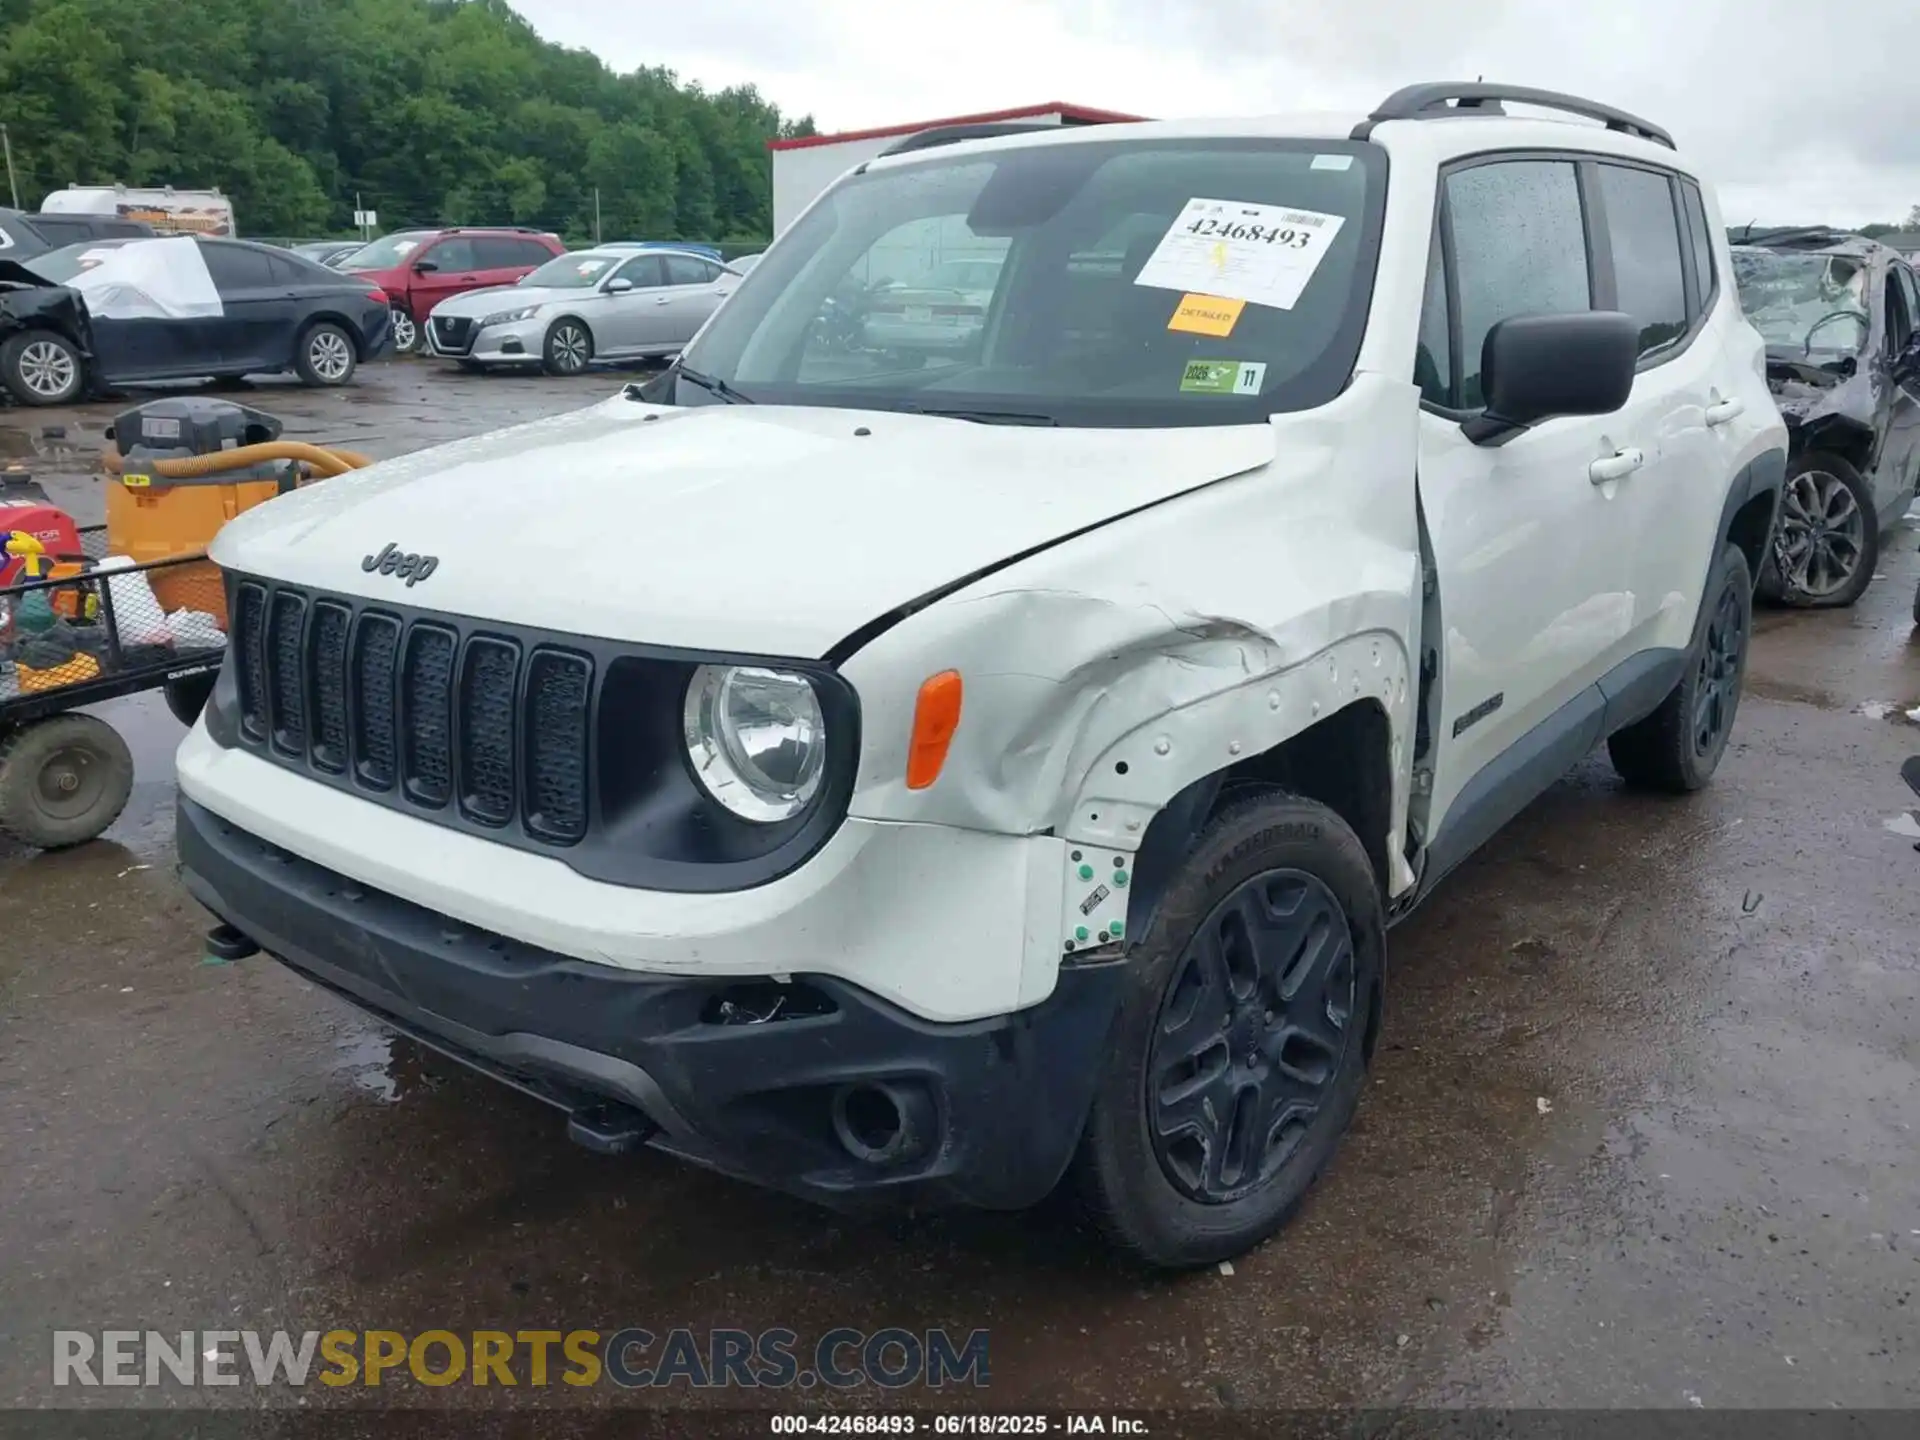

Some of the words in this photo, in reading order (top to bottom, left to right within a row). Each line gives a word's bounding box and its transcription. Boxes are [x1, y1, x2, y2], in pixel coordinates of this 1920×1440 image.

[1187, 218, 1311, 249] 42468493
[1180, 308, 1232, 322] DETAILED
[1243, 369, 1257, 387] 11
[361, 542, 440, 588] Jeep
